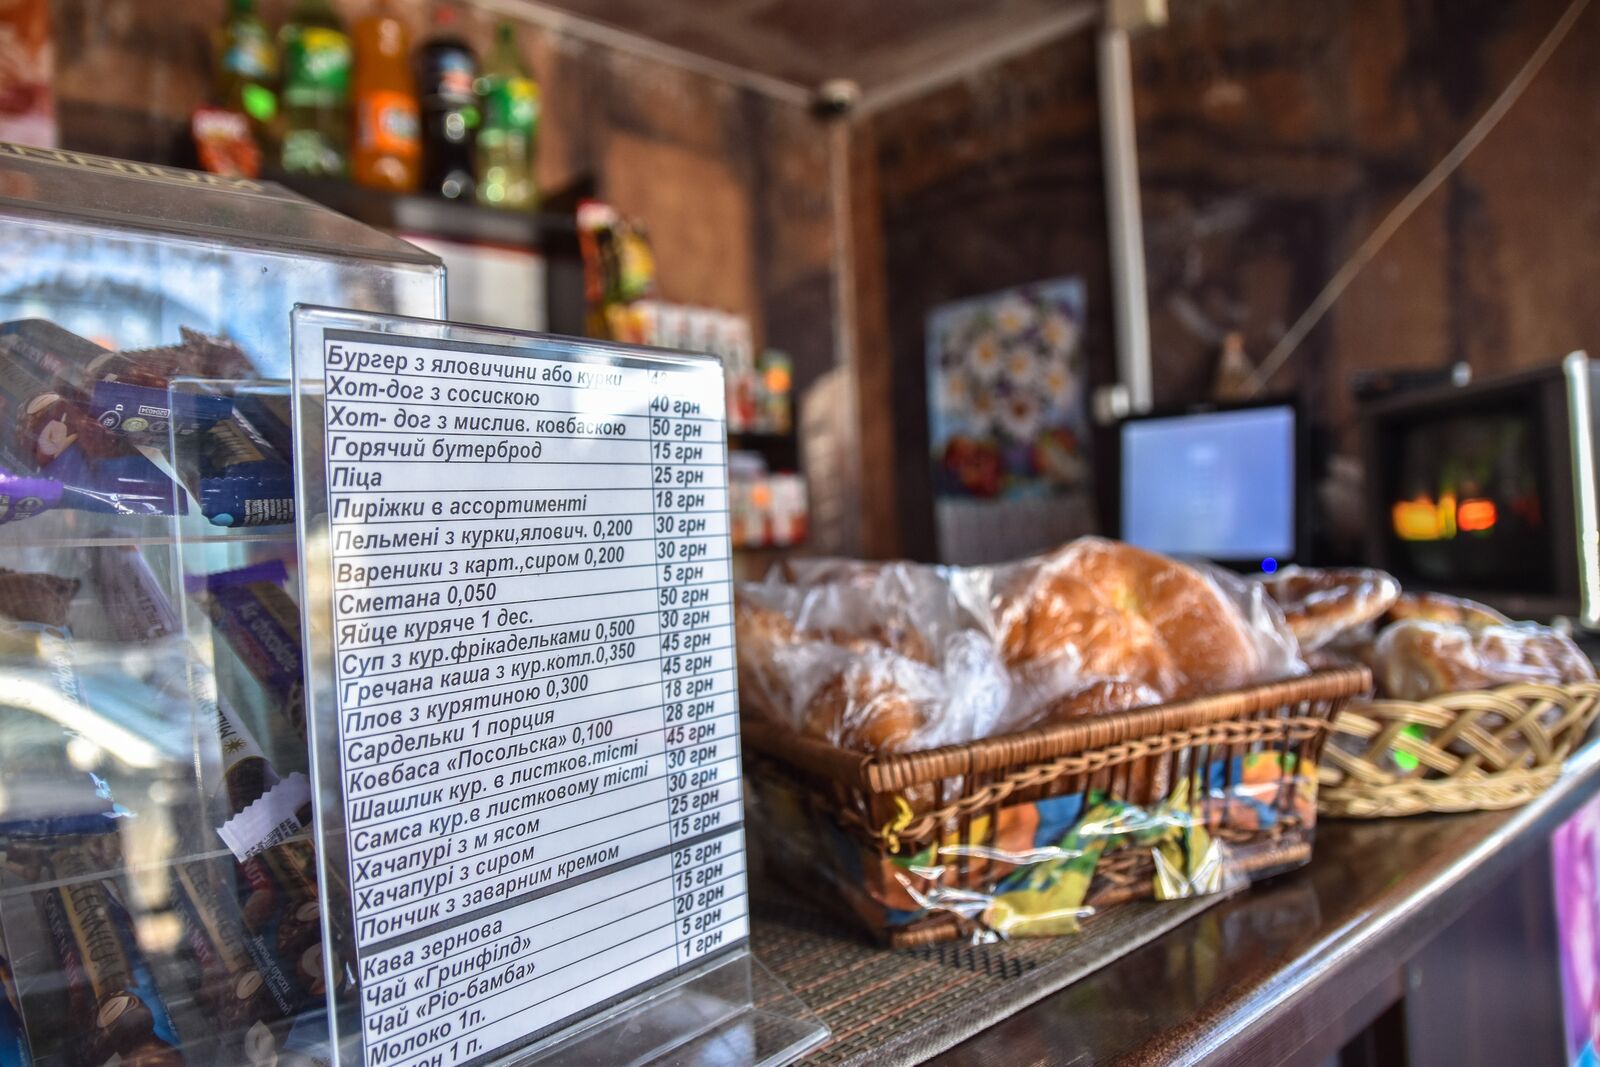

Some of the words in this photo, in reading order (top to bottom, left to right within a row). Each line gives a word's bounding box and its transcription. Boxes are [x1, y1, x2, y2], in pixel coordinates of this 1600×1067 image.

[328, 345, 408, 372] Бургер
[413, 357, 424, 371] з
[430, 358, 536, 380] яловичини
[541, 365, 572, 383] або
[328, 376, 423, 400] Хот-дог
[430, 386, 440, 401] з
[446, 387, 539, 406] сосискою
[649, 396, 669, 414] 40
[673, 400, 700, 416] грн
[328, 405, 386, 427] Хот-
[393, 407, 430, 428] дог
[436, 415, 447, 429] з
[453, 416, 529, 432] мислив.
[535, 416, 626, 436] ковбаскою
[651, 418, 670, 435] 50
[674, 423, 702, 439] грн
[331, 436, 425, 458] Горячий
[431, 437, 542, 461] бутерброд
[653, 441, 670, 459] 15
[674, 446, 703, 462] грн
[332, 466, 382, 488] Піца
[653, 465, 672, 483] 25
[676, 470, 704, 486] грн
[333, 497, 425, 521] Пиріжки
[431, 501, 443, 515] в
[449, 493, 587, 517] ассортименті
[655, 490, 673, 508] 18
[677, 494, 705, 510] грн
[336, 526, 439, 550] Пельмені
[444, 530, 454, 545] з
[593, 519, 633, 540] 0,200
[655, 515, 674, 533] 30
[678, 518, 706, 535] грн
[657, 540, 675, 559] 30
[679, 543, 707, 559] грн
[337, 561, 442, 585] Вареники
[448, 560, 458, 575] з
[584, 545, 624, 567] 0,200
[662, 564, 672, 582] 5
[675, 566, 703, 583] грн
[338, 591, 440, 614] Сметана
[447, 582, 496, 606] 0,050
[659, 587, 677, 606] 50
[681, 588, 709, 606] грн
[340, 622, 397, 645] Яйце
[404, 616, 474, 640] куряче
[481, 609, 490, 628] 1
[496, 607, 533, 626] дес.
[660, 610, 678, 629] 30
[682, 610, 710, 629] грн
[342, 653, 384, 676] Суп
[390, 652, 401, 668] з
[595, 618, 635, 640] 0,500
[661, 633, 679, 651] 45
[683, 632, 711, 651] грн
[662, 656, 681, 675] 45
[684, 655, 712, 673] грн
[343, 675, 433, 705] Гречана
[440, 667, 489, 688] каша
[495, 664, 505, 679] з
[664, 679, 681, 698] 18
[686, 677, 713, 696] грн
[345, 709, 402, 733] Плов
[409, 706, 419, 722] з
[426, 686, 540, 721] курятиною
[546, 673, 588, 699] 0,300
[664, 701, 683, 723] 28
[687, 700, 715, 718] грн
[347, 727, 464, 762] Сардельки
[471, 719, 479, 738] 1
[487, 709, 554, 735] порция
[665, 724, 684, 745] 45
[688, 722, 716, 741] грн
[349, 760, 439, 793] Ковбаса
[446, 734, 567, 771] «Посольска»
[572, 719, 613, 745] 0,100
[667, 748, 686, 769] 30
[689, 744, 717, 764] грн
[668, 771, 687, 792] 30
[690, 767, 718, 787] грн
[351, 787, 443, 823] Шашлик
[449, 779, 487, 800] кур.
[493, 774, 504, 788] в
[354, 822, 422, 852] Самса
[485, 776, 599, 819] листковому
[604, 762, 648, 787] тісті
[671, 796, 688, 815] 25
[692, 789, 719, 810] грн
[672, 817, 689, 837] 15
[693, 811, 720, 832] грн
[355, 842, 452, 882] Хачапурі
[457, 838, 467, 853] з
[473, 832, 487, 849] м
[493, 818, 540, 844] ясом
[674, 849, 691, 870] 25
[695, 841, 722, 863] грн
[358, 868, 453, 911] Хачапурі
[459, 865, 469, 880] з
[475, 845, 534, 875] сиром
[675, 874, 693, 892] 15
[696, 862, 723, 885] грн
[361, 902, 440, 940] Пончик
[445, 897, 455, 913] з
[461, 866, 552, 908] заварним
[557, 845, 619, 877] кремом
[676, 896, 693, 914] 20
[697, 884, 724, 907] грн
[682, 917, 691, 935] 5
[694, 908, 721, 930] грн
[363, 950, 414, 979] Кава
[420, 919, 502, 960] зернова
[683, 939, 691, 957] 1
[696, 930, 723, 952] грн
[367, 979, 406, 1006] Чай
[413, 935, 531, 990] «Гринфілд»
[369, 1005, 409, 1035] Чай
[416, 962, 535, 1018] «Ріо-бамба»
[370, 1022, 451, 1067] Молоко
[458, 1009, 485, 1030] 1п.
[449, 1041, 458, 1061] 1
[465, 1038, 482, 1055] п.
